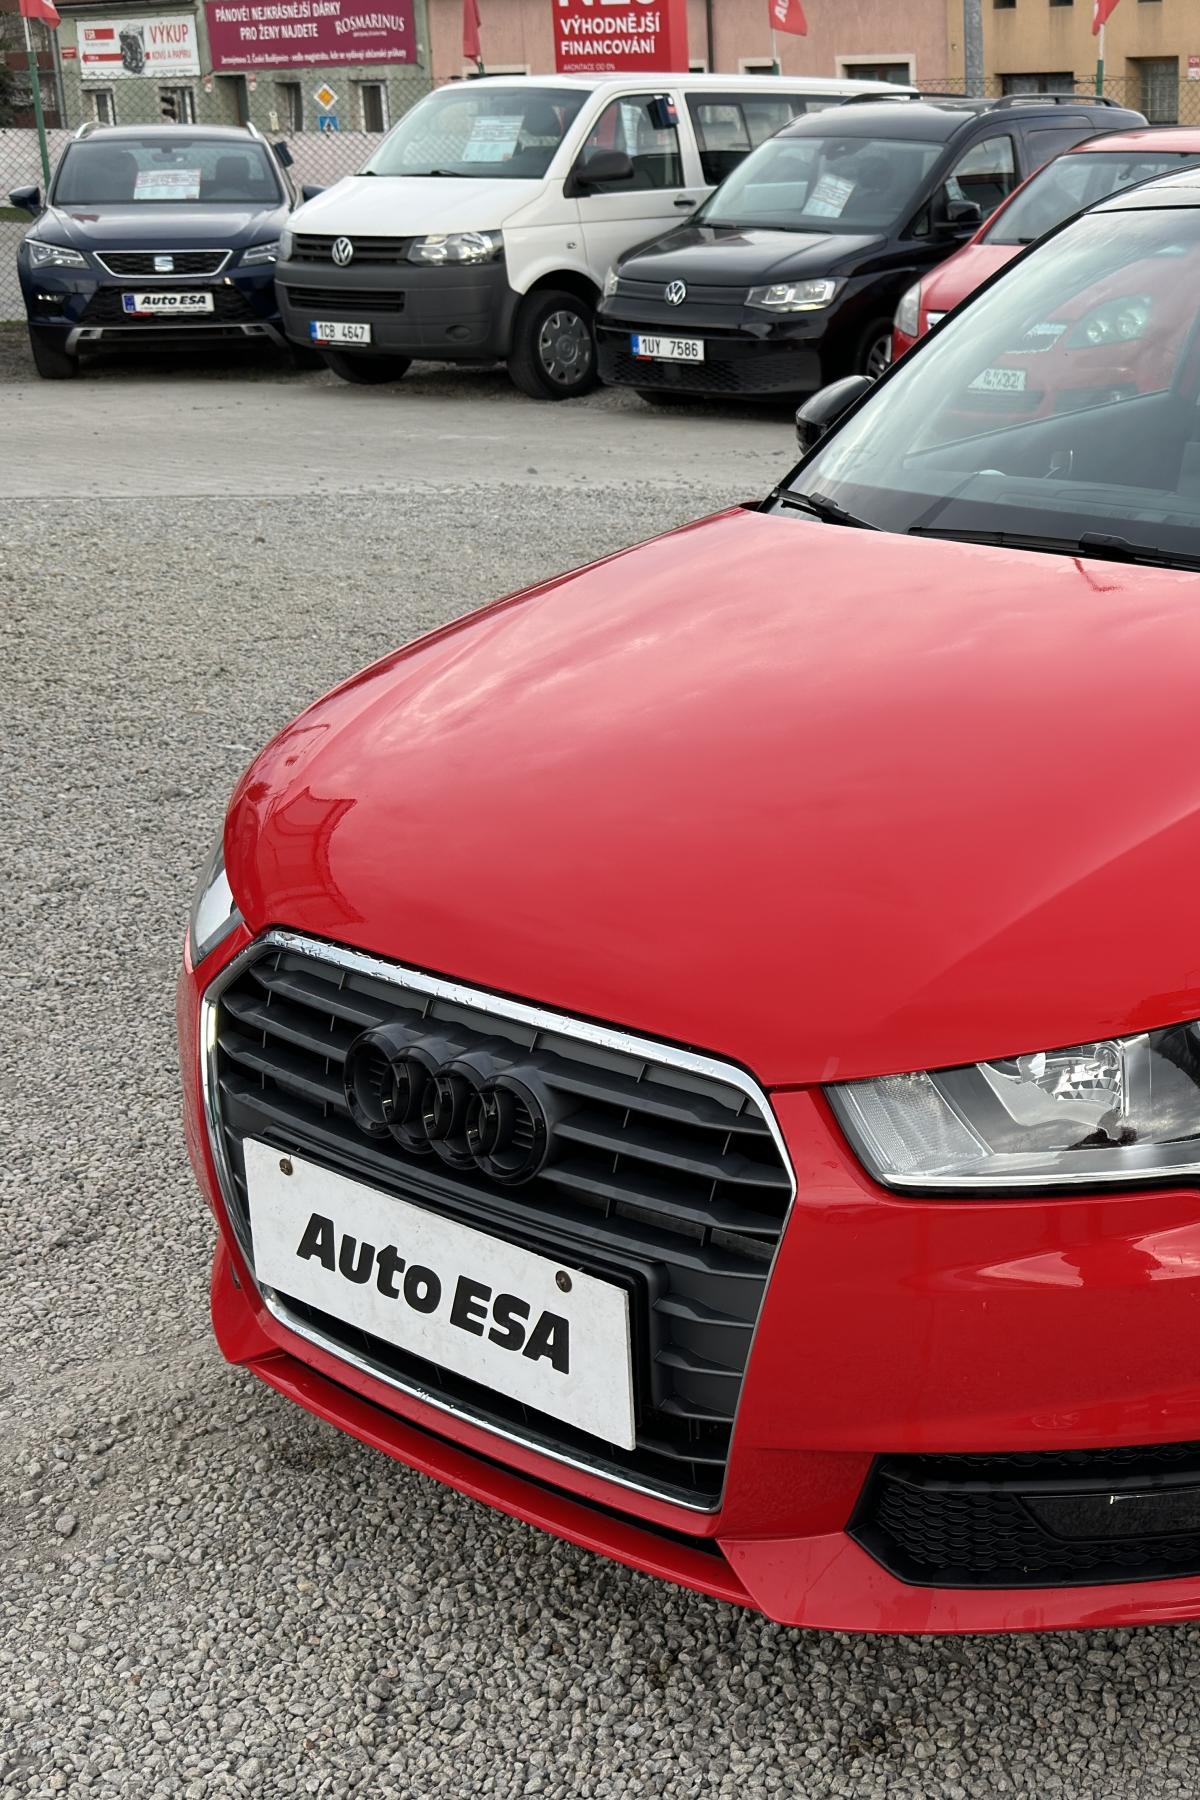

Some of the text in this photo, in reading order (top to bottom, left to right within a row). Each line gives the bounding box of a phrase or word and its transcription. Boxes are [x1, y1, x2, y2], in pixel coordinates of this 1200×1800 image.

[215, 1, 341, 22] PÁNOVÉ! NEJKRÁSNĚJŠÍ DÁRKY
[149, 22, 189, 44] VÝKUP
[240, 23, 319, 40] PRO ŽENY NAJDETE
[334, 13, 405, 35] ROSMARINUS
[560, 12, 661, 35] VÝHODNĚJŠÍ
[561, 36, 656, 55] FINANCOVÁNÍ
[141, 295, 206, 305] Auto ESA
[342, 325, 365, 339] 4647
[642, 338, 698, 357] 1UY 7586
[296, 1212, 570, 1376] Auto ESA
